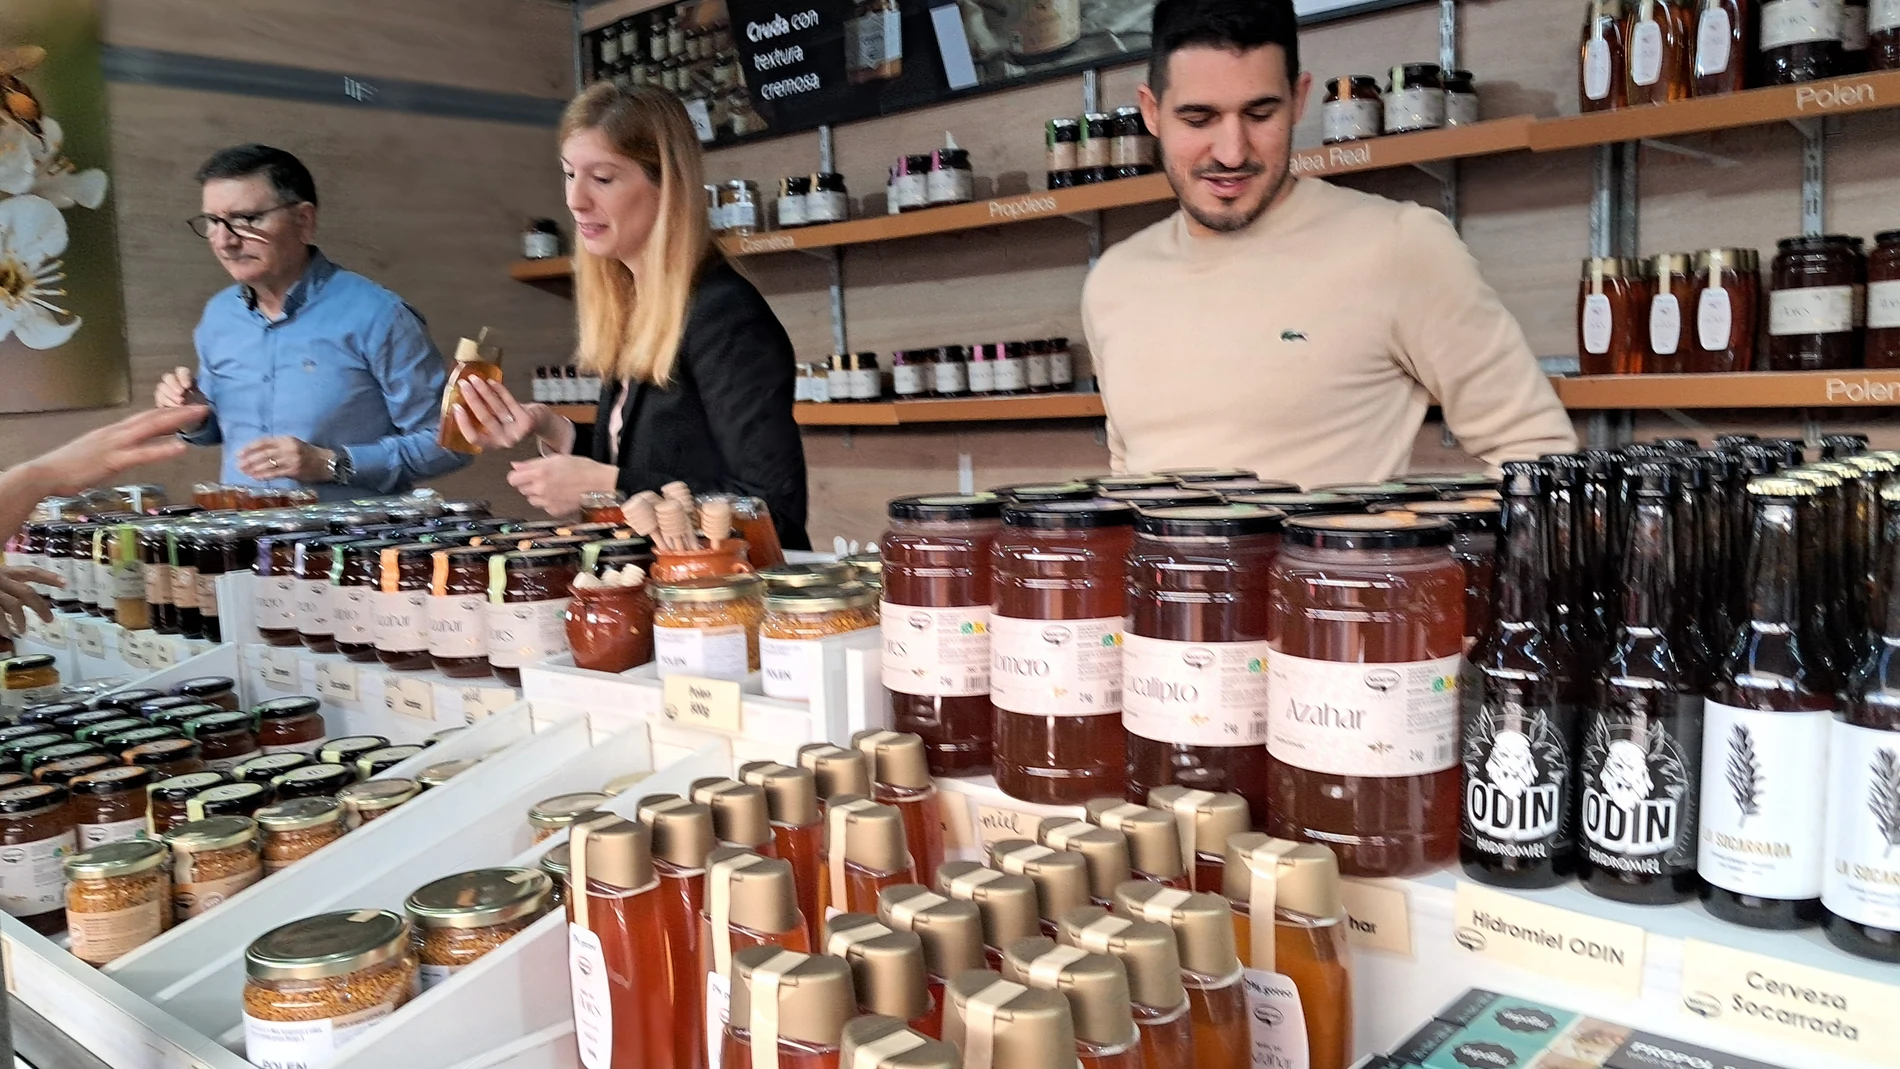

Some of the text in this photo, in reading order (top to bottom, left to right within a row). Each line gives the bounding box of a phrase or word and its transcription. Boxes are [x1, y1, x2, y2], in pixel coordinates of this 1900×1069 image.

[746, 9, 819, 42] Cruda con
[753, 45, 804, 71] textura
[761, 72, 821, 100] cremosa
[1796, 83, 1875, 110] Polen
[1289, 144, 1371, 172] alea Real
[994, 651, 1049, 677] omero
[1125, 676, 1199, 705] ucalipto
[1286, 697, 1367, 730] Azahar
[1470, 781, 1557, 837] ODIN
[1585, 790, 1673, 850] ODIN
[1476, 835, 1547, 858] HIDROMIEL
[1715, 832, 1793, 859] SOCARRADA
[1589, 847, 1662, 874] HIDROMIEL
[1350, 915, 1378, 935] har
[1472, 909, 1625, 967] Hidromiel ODIN
[1745, 969, 1849, 1012] Cerveza
[1731, 993, 1859, 1042] Socarrada
